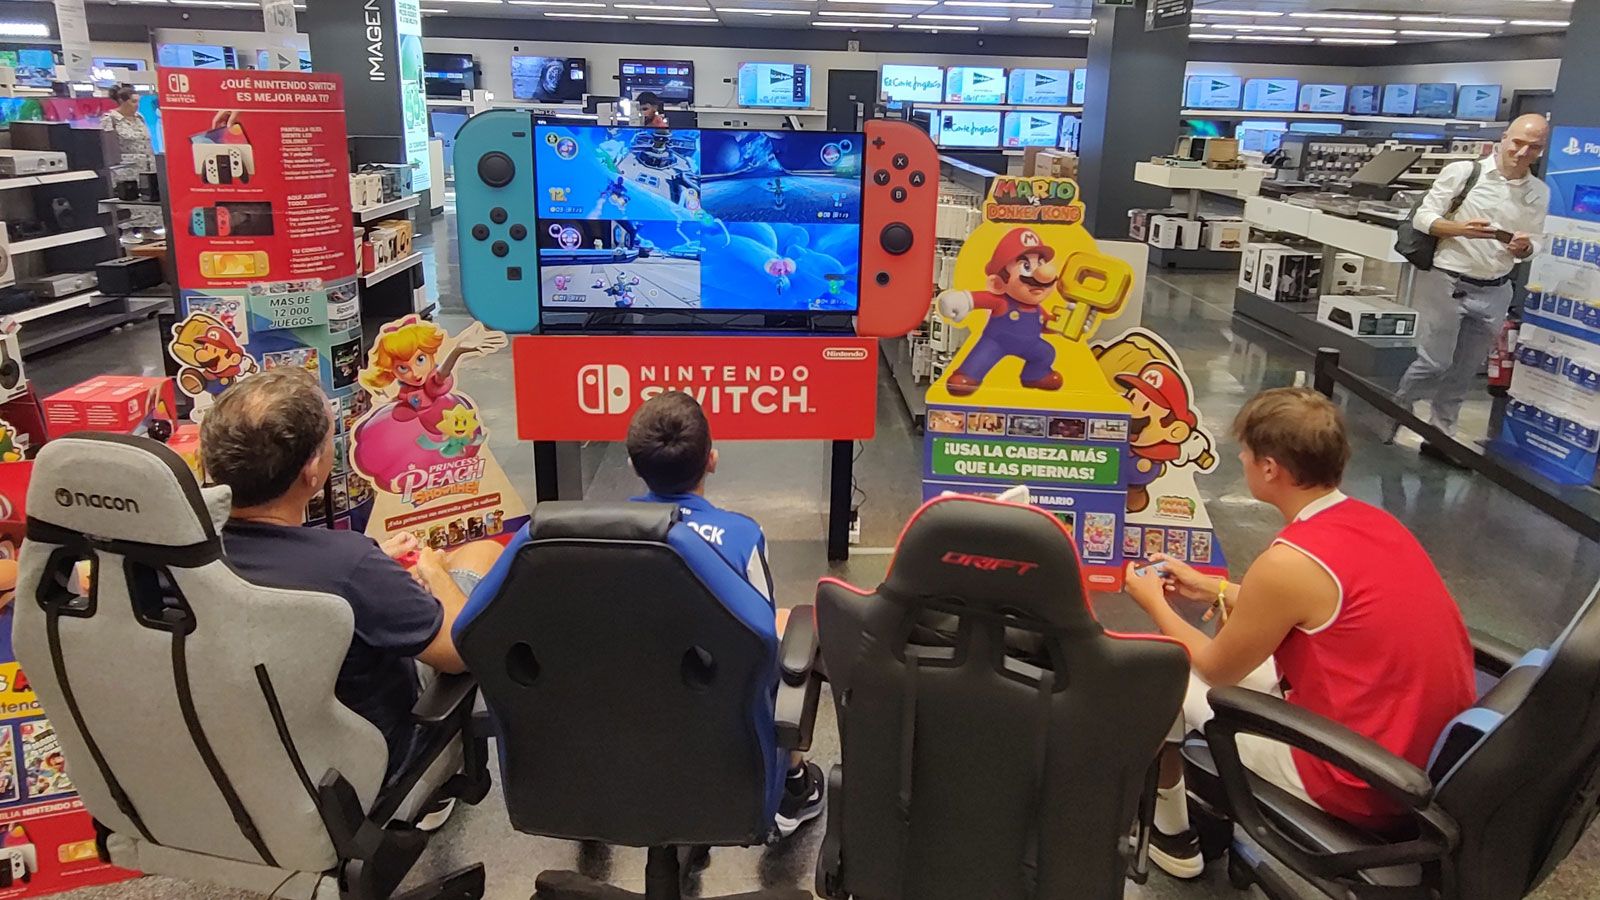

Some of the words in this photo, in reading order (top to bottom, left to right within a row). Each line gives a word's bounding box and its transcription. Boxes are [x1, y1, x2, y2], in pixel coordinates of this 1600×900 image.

[220, 77, 250, 90] ¿QUÉ
[254, 80, 307, 90] NINTENDO
[308, 81, 336, 90] SWITCH
[237, 93, 251, 102] ES
[254, 93, 293, 102] MEJOR
[294, 94, 318, 103] PARA
[896, 158, 903, 166] X
[879, 174, 886, 182] Y
[913, 175, 921, 183] A
[895, 191, 902, 199] B
[994, 179, 1076, 199] MARIO
[987, 203, 1041, 220] DONKEY
[1041, 204, 1081, 221] KONG
[297, 296, 311, 305] DE
[270, 317, 313, 328] JUEGOS
[825, 350, 865, 358] Nintendo
[640, 365, 809, 382] NINTENDO
[944, 442, 981, 456] ¡USA
[983, 445, 1004, 458] LA
[1005, 446, 1068, 461] CABEZA
[1070, 448, 1108, 463] MÁS
[429, 456, 478, 473] PRINCESS
[954, 460, 987, 475] QUE
[989, 463, 1020, 475] LAS
[1021, 465, 1095, 480] PIERNAS!
[391, 459, 486, 503] PEACH
[74, 492, 140, 514] nacon
[1039, 496, 1074, 505] MARIO
